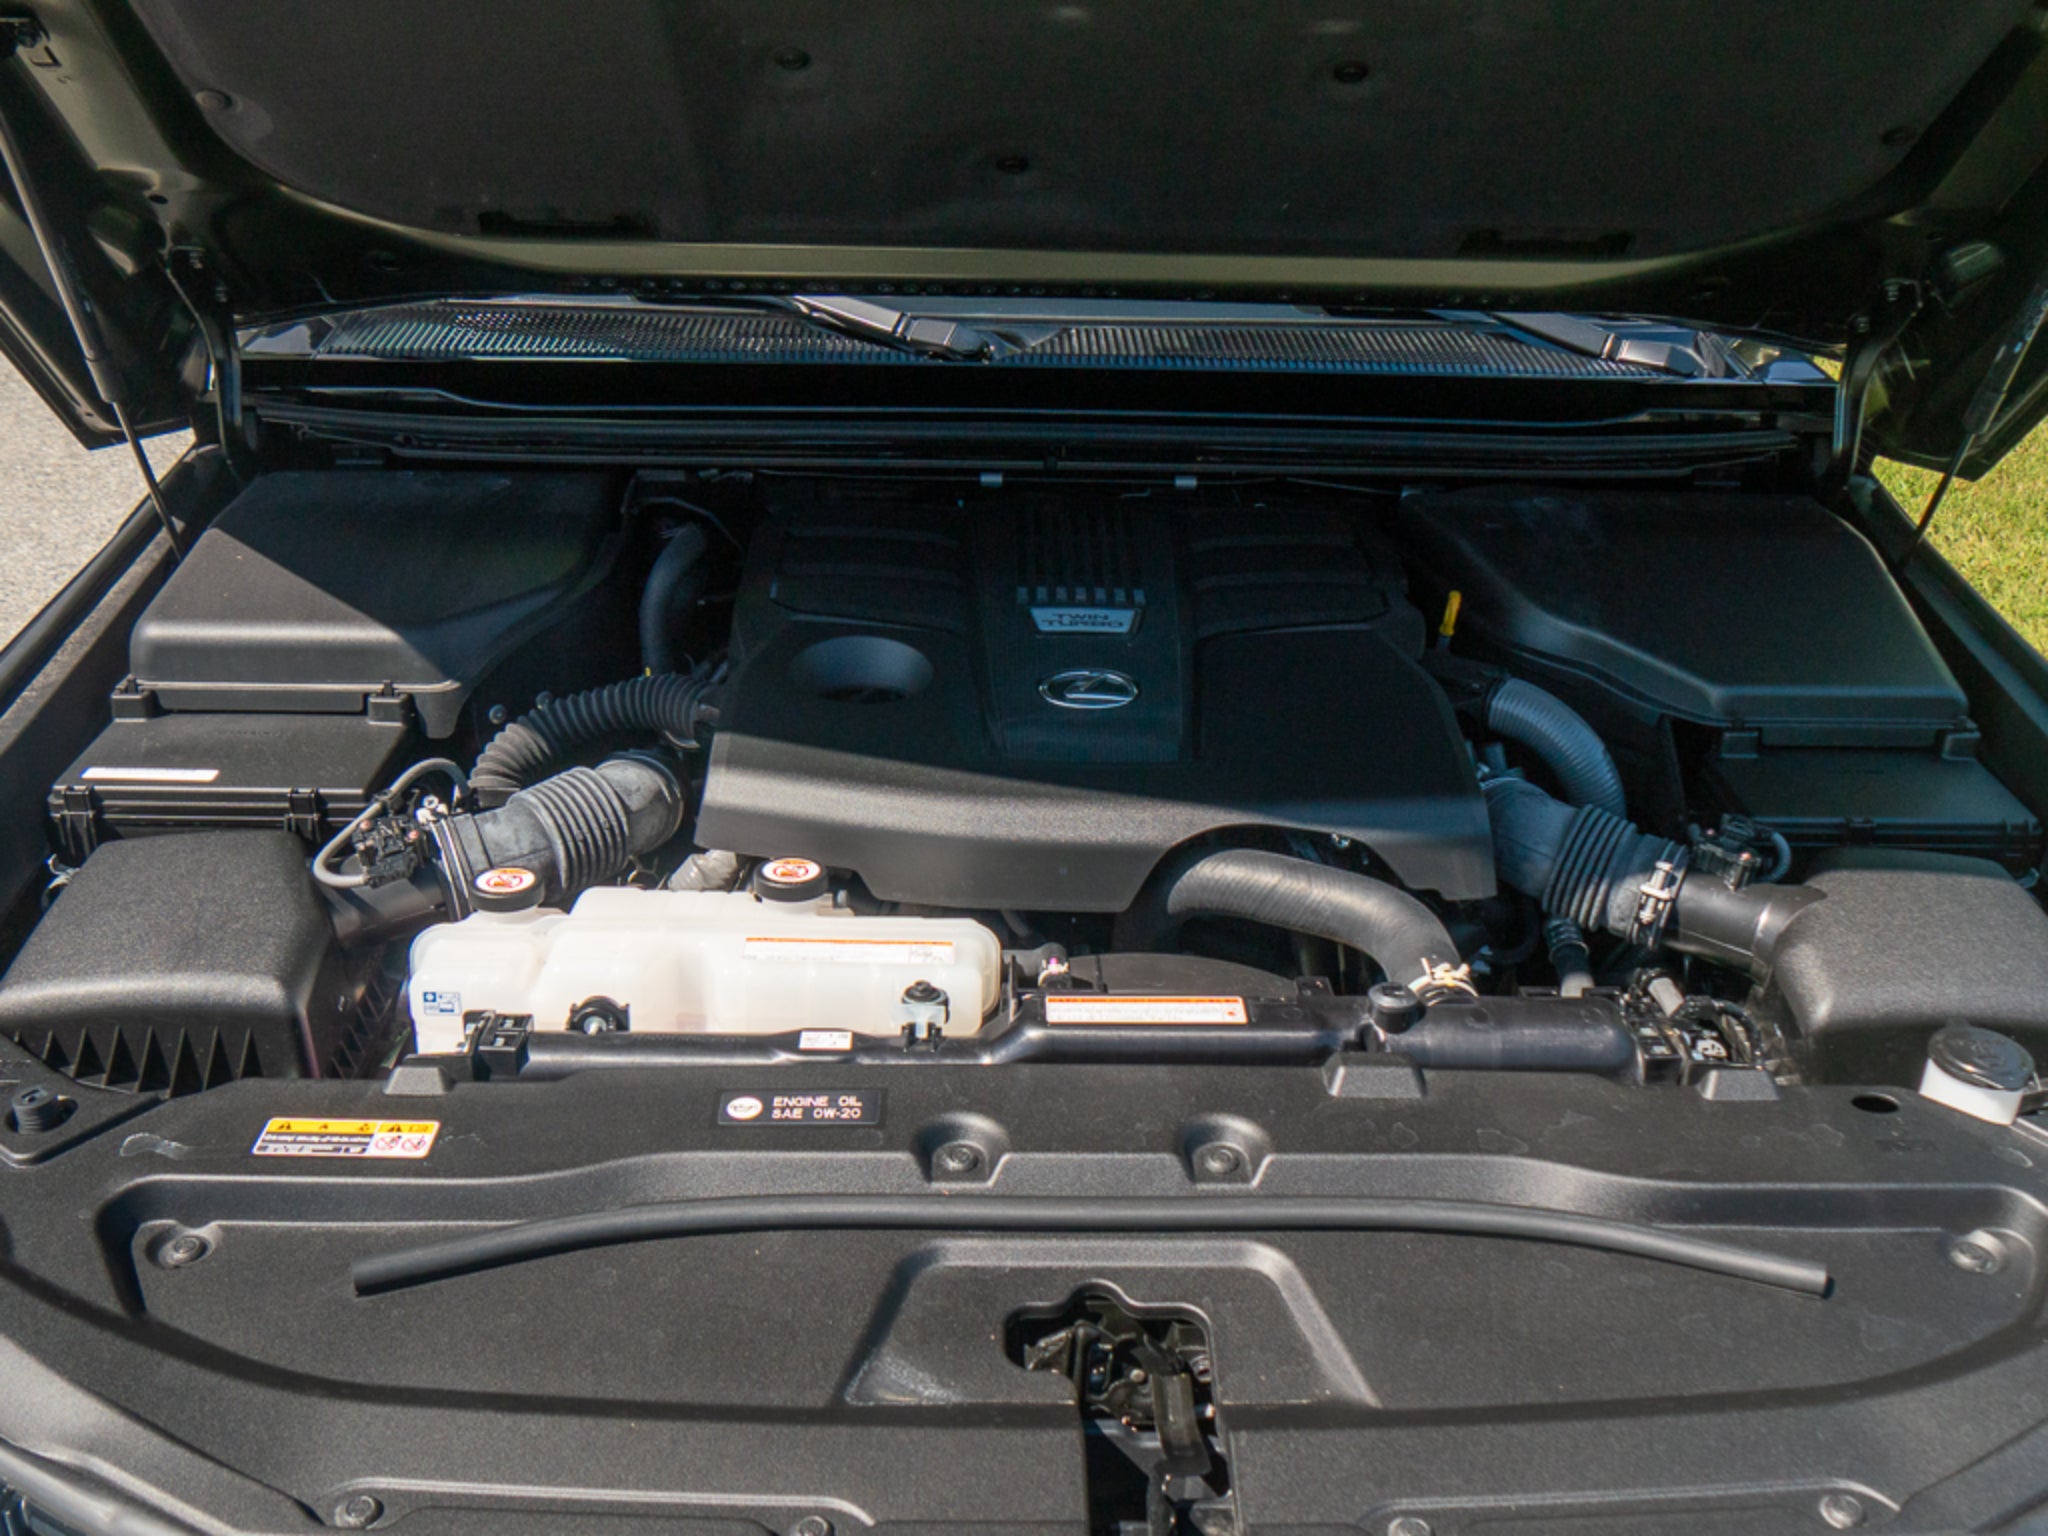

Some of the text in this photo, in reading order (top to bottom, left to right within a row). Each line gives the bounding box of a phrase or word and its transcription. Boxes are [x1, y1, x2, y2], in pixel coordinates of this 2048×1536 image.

[1051, 613, 1110, 621] TWIN
[1041, 620, 1125, 628] TURBO
[772, 1095, 862, 1107] ENGINE OIL
[771, 1108, 862, 1119] SAE 0W-20
